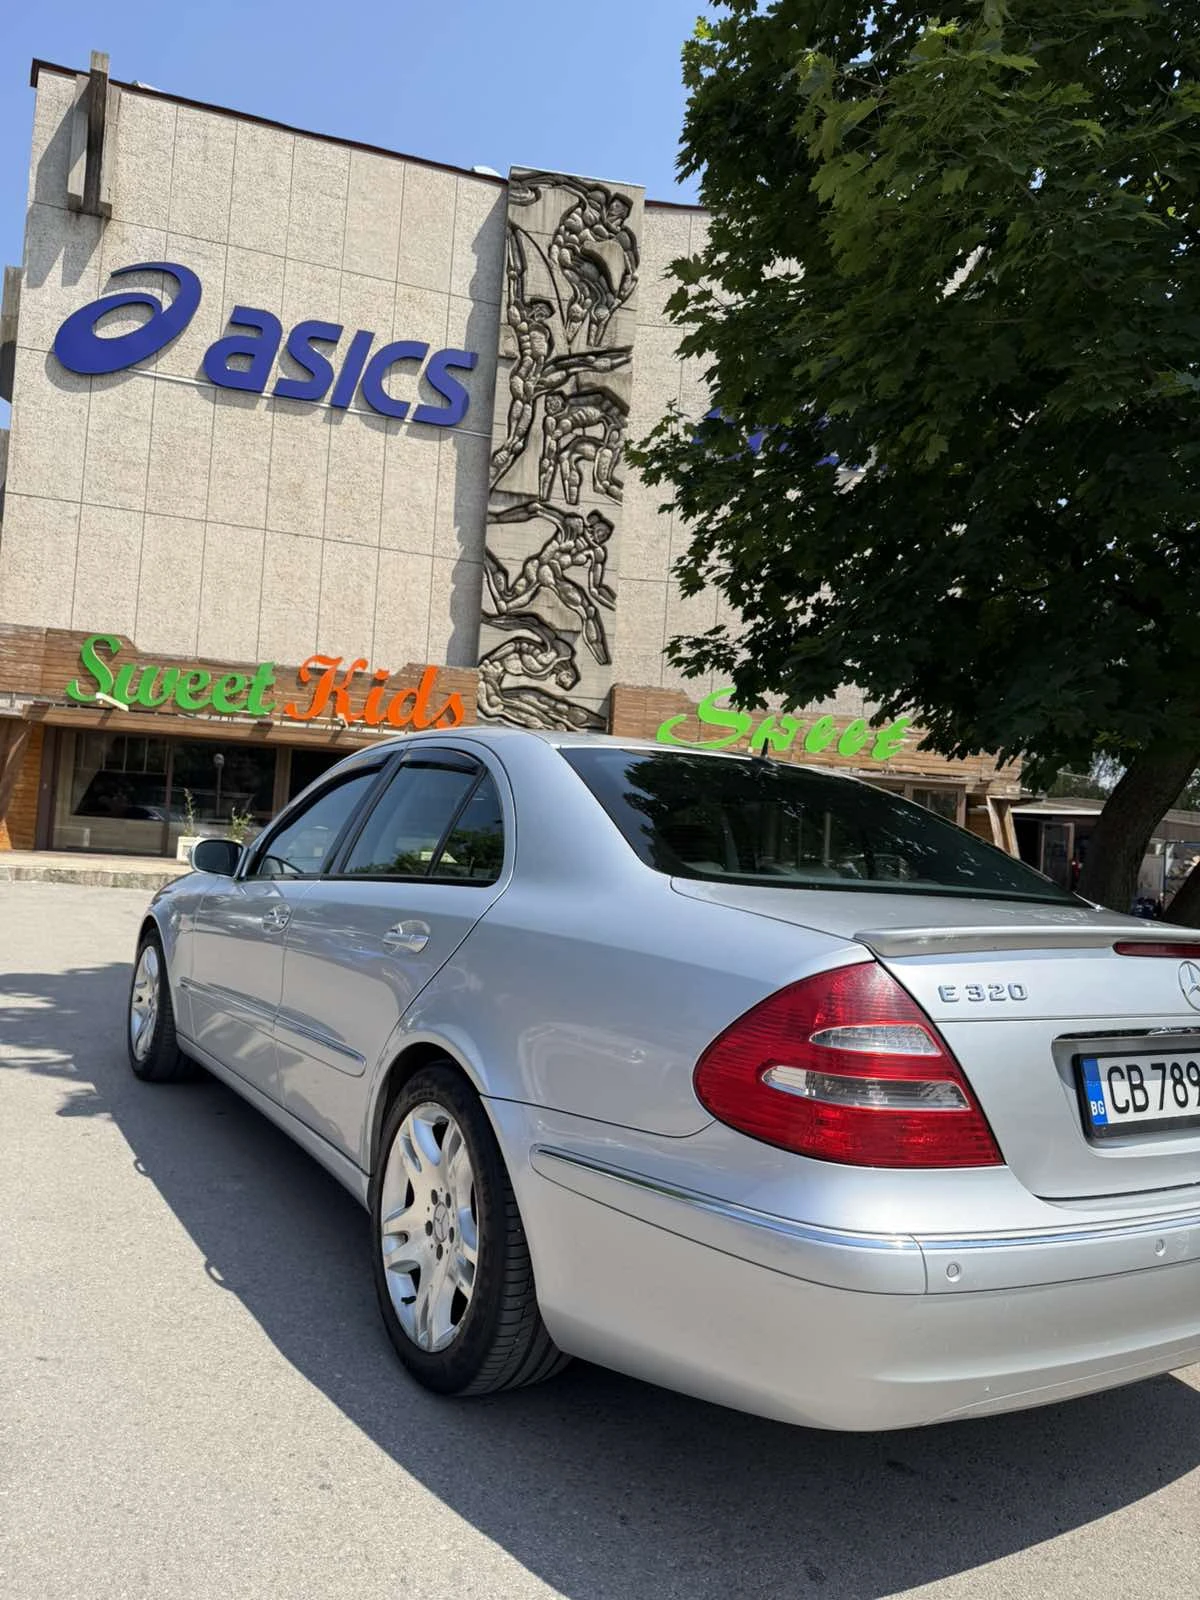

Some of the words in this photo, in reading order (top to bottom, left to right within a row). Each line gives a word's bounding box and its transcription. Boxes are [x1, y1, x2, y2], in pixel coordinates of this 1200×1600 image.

[66, 634, 276, 715] Sweet
[284, 655, 466, 729] Kids
[656, 687, 912, 761] Sweet
[938, 984, 960, 1003] E
[965, 983, 1028, 1002] 320
[1091, 1100, 1105, 1117] BG
[1107, 1064, 1149, 1114] CB
